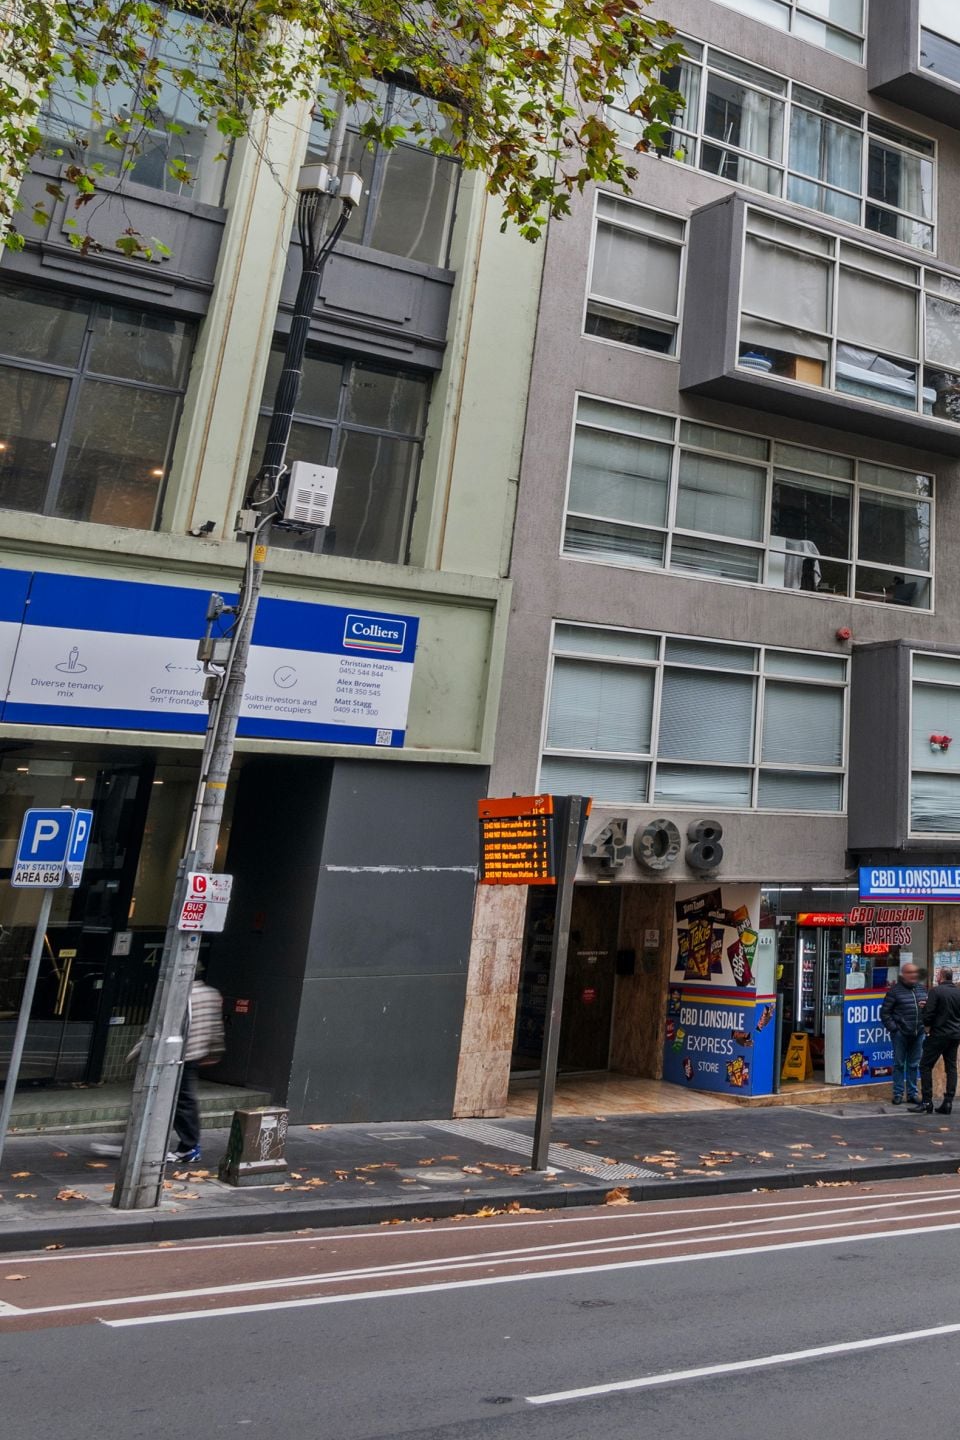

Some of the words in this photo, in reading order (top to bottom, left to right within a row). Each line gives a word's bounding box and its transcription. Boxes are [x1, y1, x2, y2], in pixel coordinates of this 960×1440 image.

[352, 622, 399, 639] Colliers
[340, 659, 371, 668] Christian
[31, 678, 65, 688] Diverse
[68, 681, 104, 692] tenancy
[337, 678, 352, 687] Alex
[354, 680, 381, 689] Browne
[57, 689, 74, 697] mix
[150, 687, 202, 697] Commandin
[354, 688, 368, 696] 350
[168, 696, 204, 706] frontage
[244, 693, 264, 702] Suits
[266, 695, 300, 705] investors
[302, 698, 317, 706] and
[335, 698, 351, 706] Matt
[353, 699, 372, 709] Stagg
[248, 703, 273, 712] owner
[274, 704, 312, 715] occupiers
[31, 820, 59, 853] P
[73, 821, 86, 854] P
[582, 817, 724, 870] 408
[15, 872, 40, 882] AREA
[43, 872, 60, 882] 654
[871, 870, 896, 888] CBD
[196, 876, 204, 891] C
[187, 904, 204, 912] BUS
[182, 912, 204, 920] ZONE
[851, 907, 875, 923] CBD
[877, 907, 924, 922] Lonsdale
[864, 926, 912, 945] EXPRESS
[864, 944, 889, 954] OPEN
[680, 1008, 698, 1025] CBD
[700, 1009, 745, 1030] LONSDALE
[848, 1006, 868, 1023] CBD
[858, 1028, 891, 1044] EXPR
[687, 1035, 734, 1055] EXPRESS
[872, 1050, 894, 1060] STORE
[698, 1061, 719, 1073] STORE
